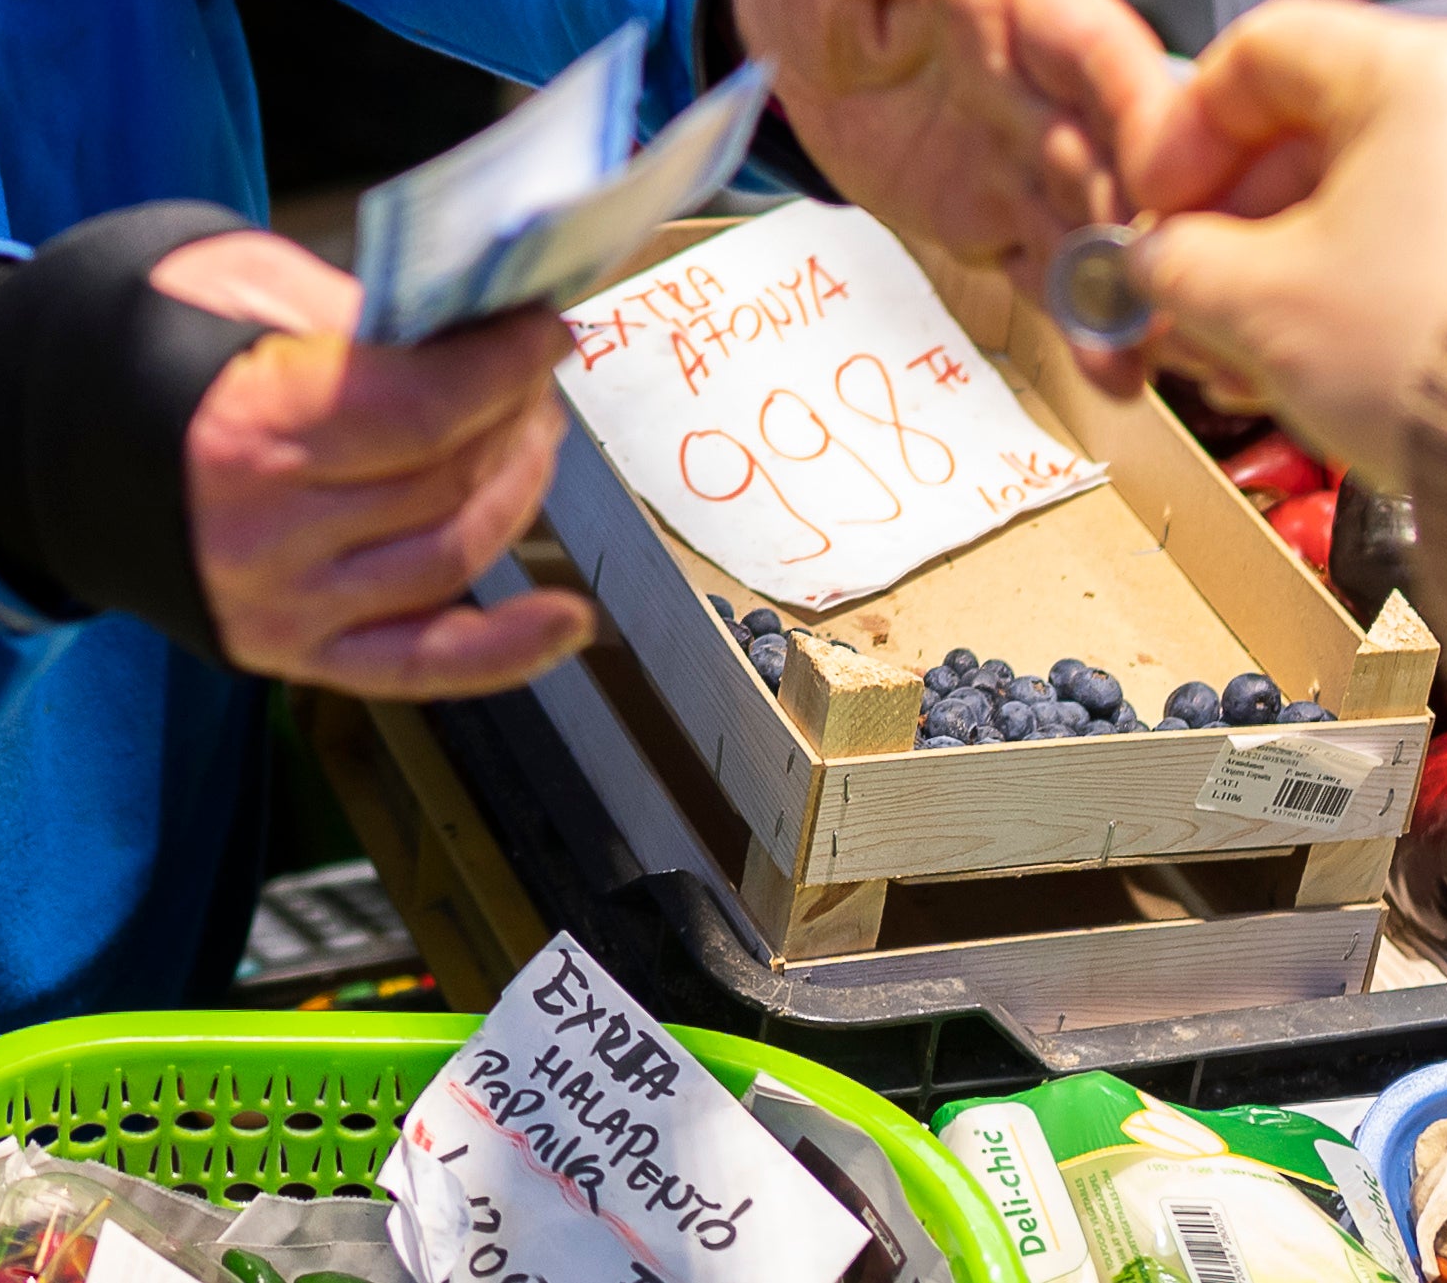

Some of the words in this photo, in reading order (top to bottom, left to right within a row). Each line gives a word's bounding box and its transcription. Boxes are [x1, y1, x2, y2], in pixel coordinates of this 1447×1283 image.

[560, 265, 726, 371] EXTRA
[679, 353, 955, 565] 998
[982, 1130, 1047, 1257] Deli-chic
[1075, 1177, 1098, 1226] VEGETABLES
